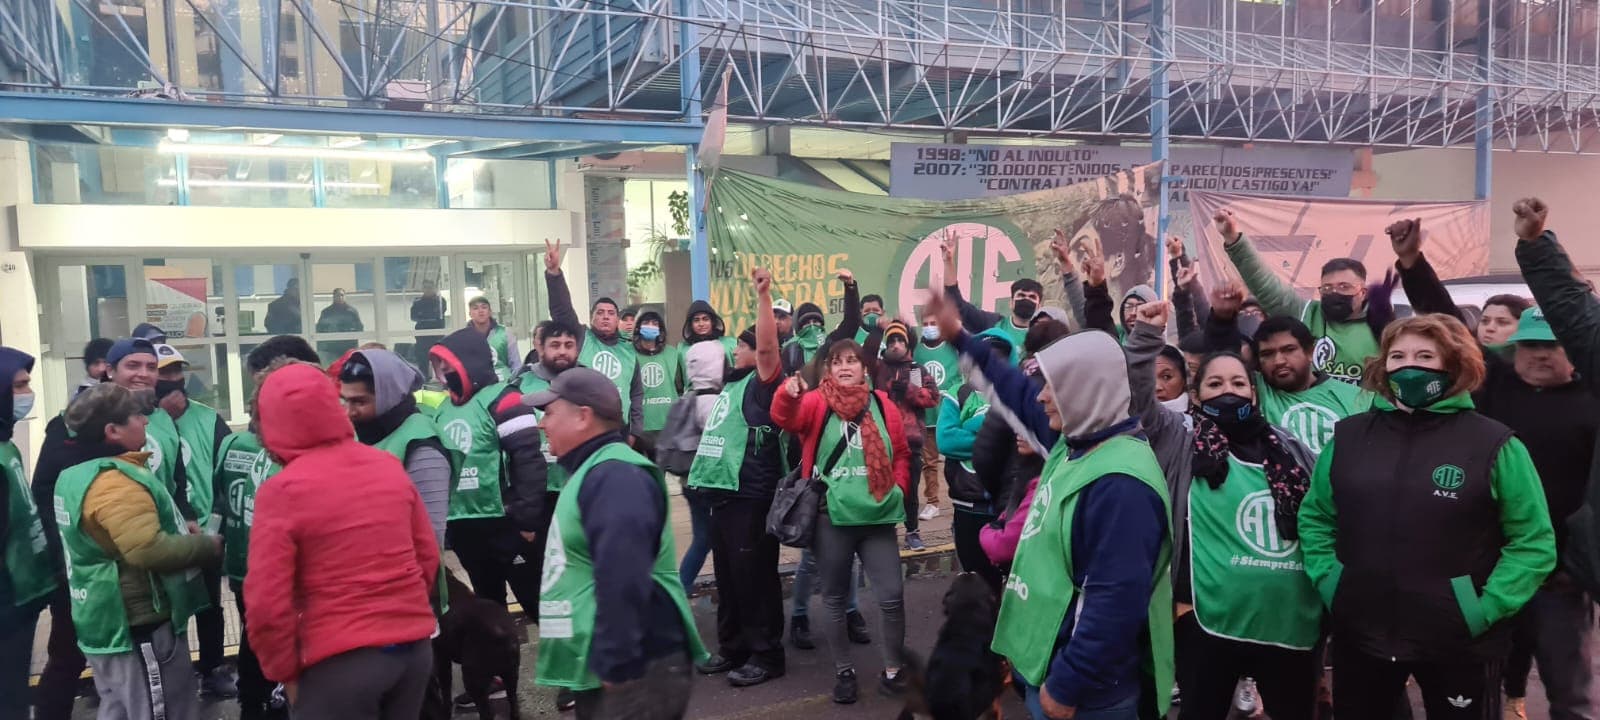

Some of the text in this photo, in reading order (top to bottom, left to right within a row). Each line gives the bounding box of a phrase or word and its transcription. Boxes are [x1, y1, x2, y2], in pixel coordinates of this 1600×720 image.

[916, 148, 966, 161] 1998:
[1001, 150, 1025, 162] AL
[913, 163, 967, 176] 2007:
[969, 164, 1036, 176] "30.000
[1221, 179, 1229, 190] Y
[1231, 178, 1289, 191] CASTIGO
[1325, 361, 1362, 377] SAO
[1426, 380, 1441, 395] ATE
[1433, 465, 1465, 488] ATE
